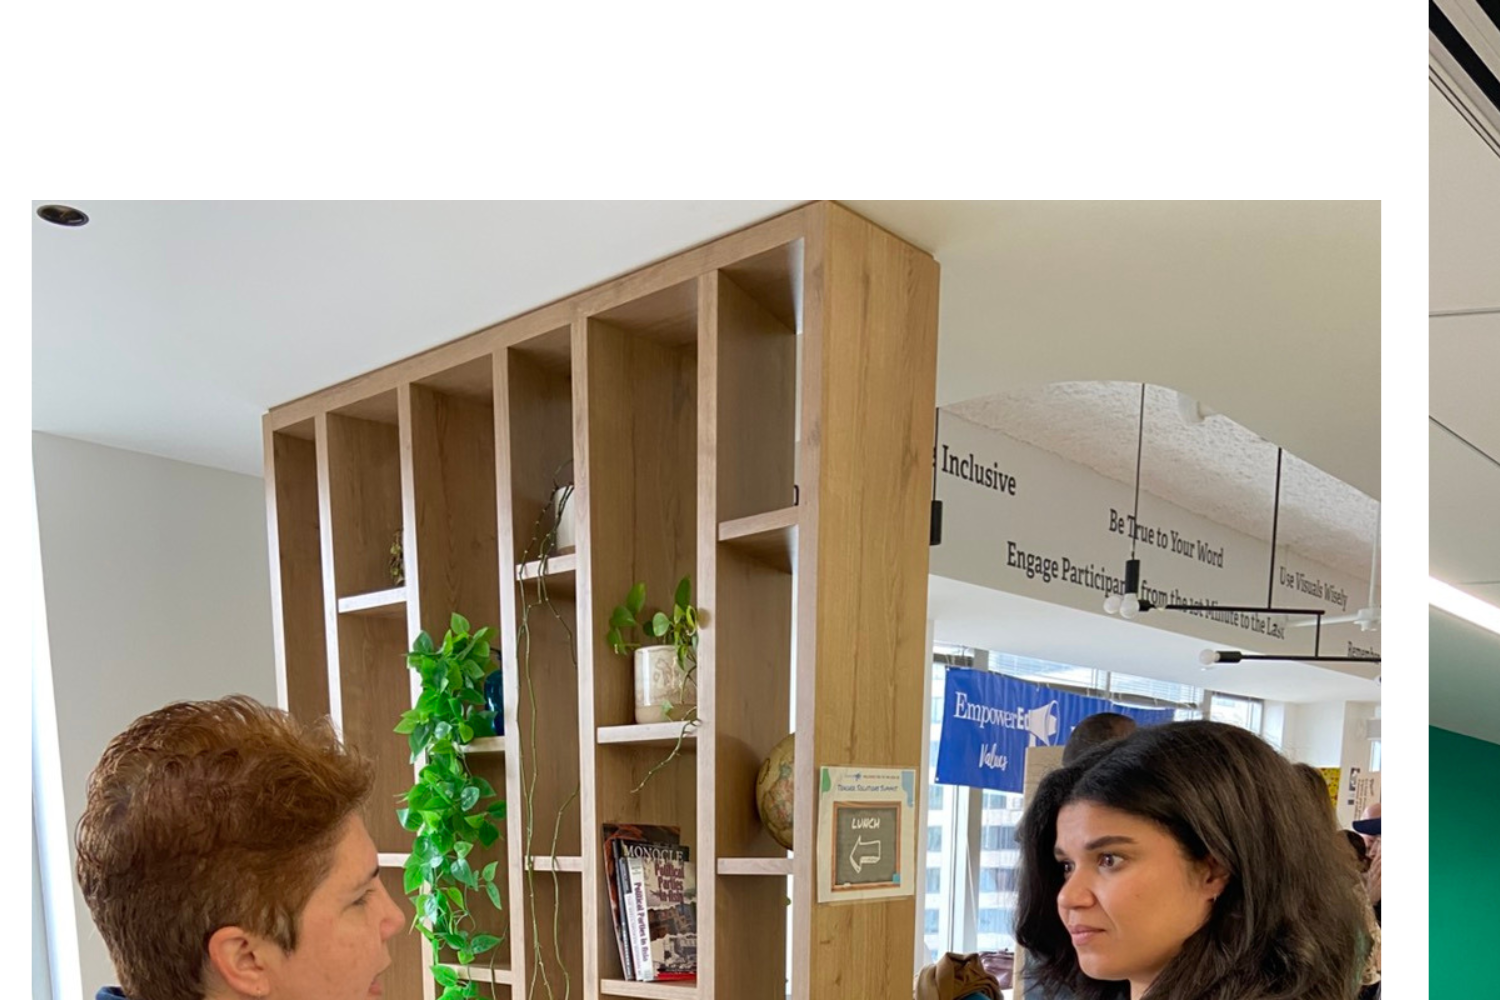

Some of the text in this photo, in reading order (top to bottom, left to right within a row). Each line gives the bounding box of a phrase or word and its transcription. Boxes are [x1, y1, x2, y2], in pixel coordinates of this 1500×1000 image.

[941, 444, 1016, 496] Inclusive
[1109, 508, 1224, 568] Be True to Your Word
[1006, 541, 1059, 583] Engage
[1240, 612, 1250, 629] to
[1250, 613, 1265, 633] the
[1266, 617, 1285, 639] Last
[1279, 566, 1349, 612] Use Visuals Wisely
[978, 743, 1008, 771] Values
[851, 818, 880, 829] LUNCH
[625, 845, 684, 861] MONOCLE
[655, 861, 685, 877] Political
[658, 877, 684, 890] Parties
[633, 882, 646, 914] Political
